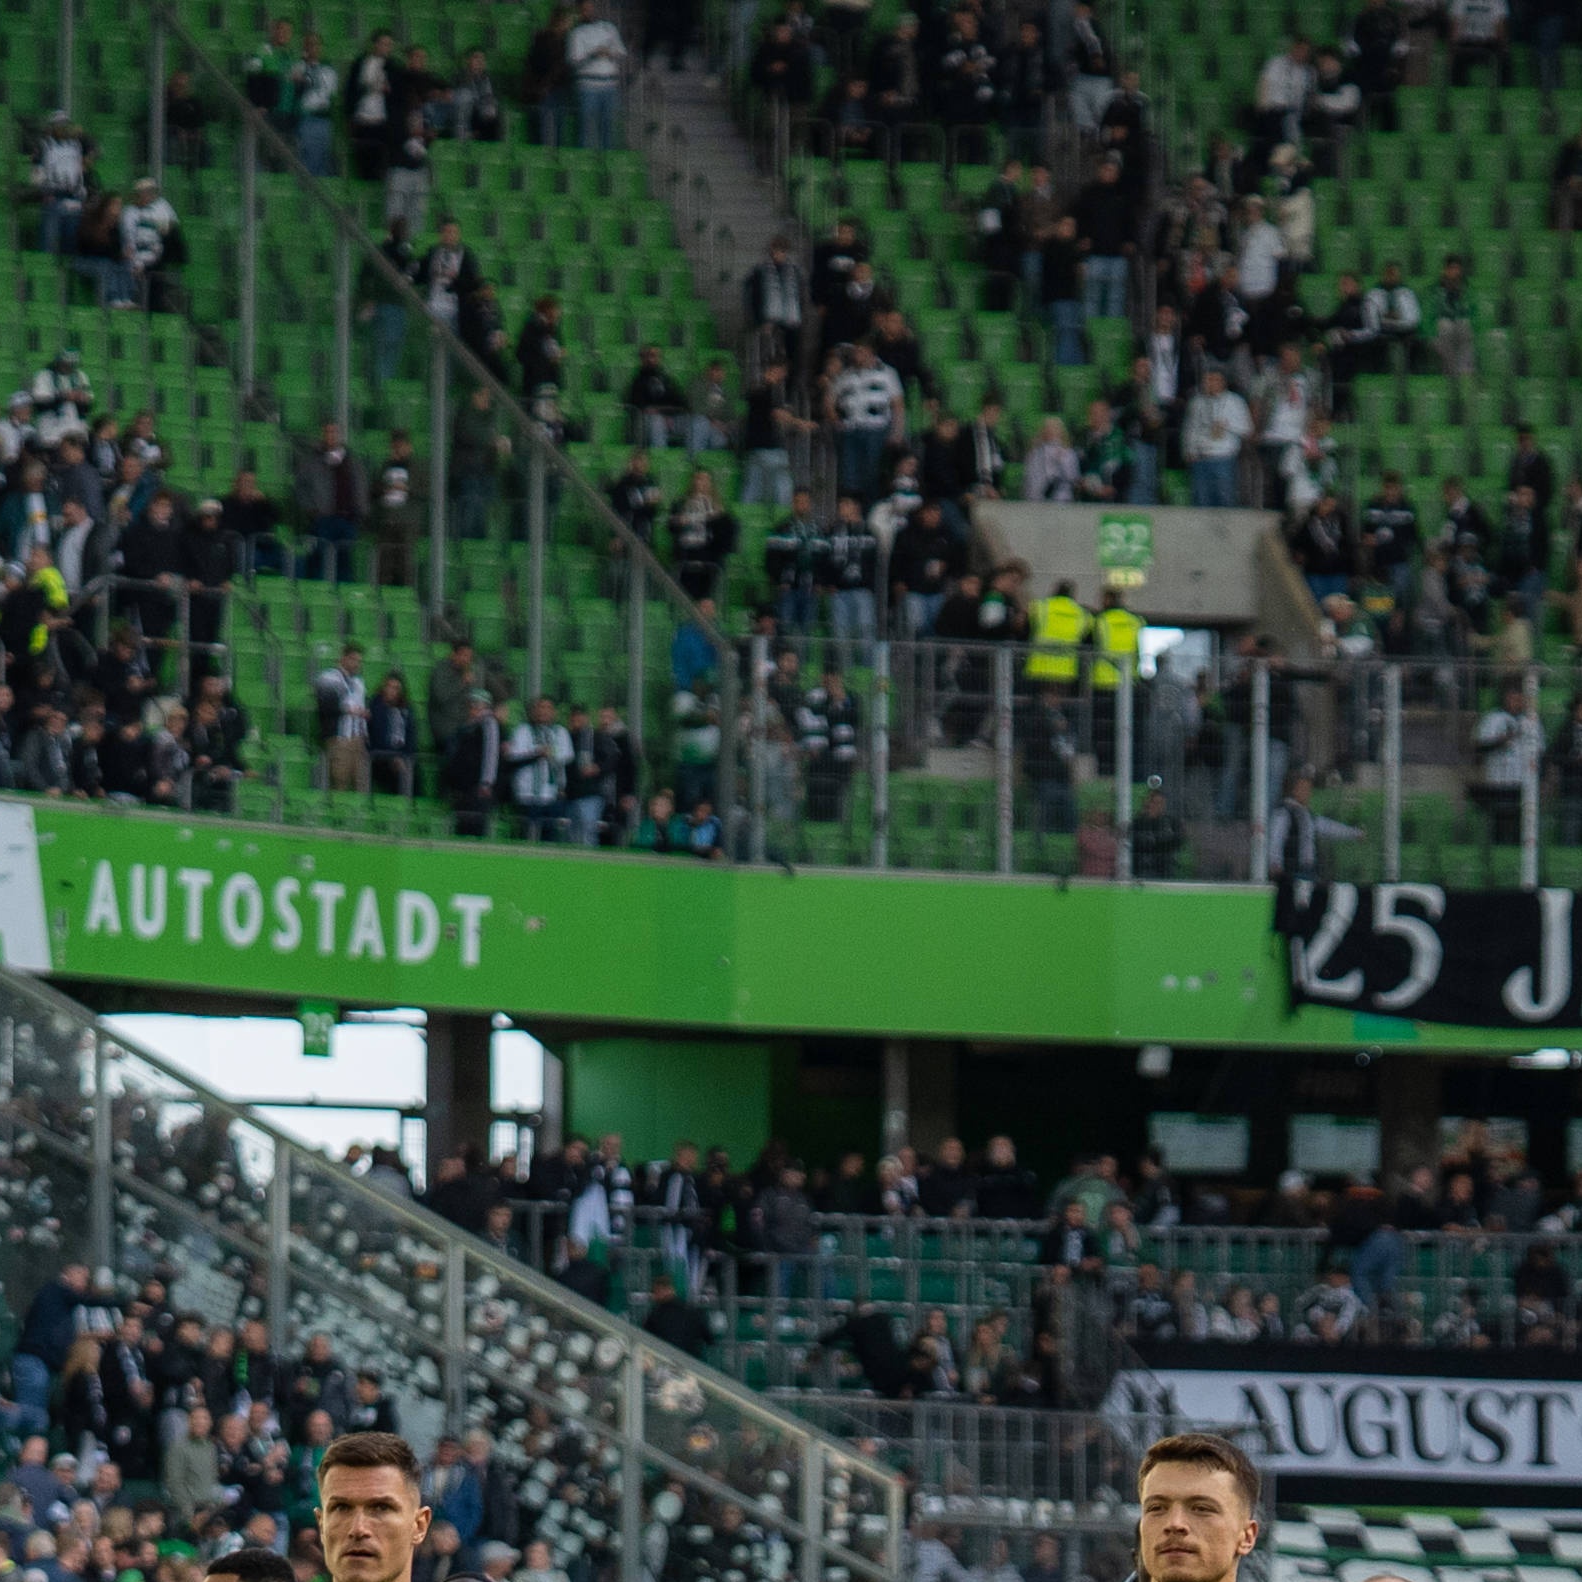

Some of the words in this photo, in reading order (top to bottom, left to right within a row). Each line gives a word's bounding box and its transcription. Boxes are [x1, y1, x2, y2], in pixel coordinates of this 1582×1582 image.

[84, 860, 494, 968] AUTOSTADT
[1294, 881, 1447, 1006] 25
[1238, 1379, 1580, 1468] AUGUST
